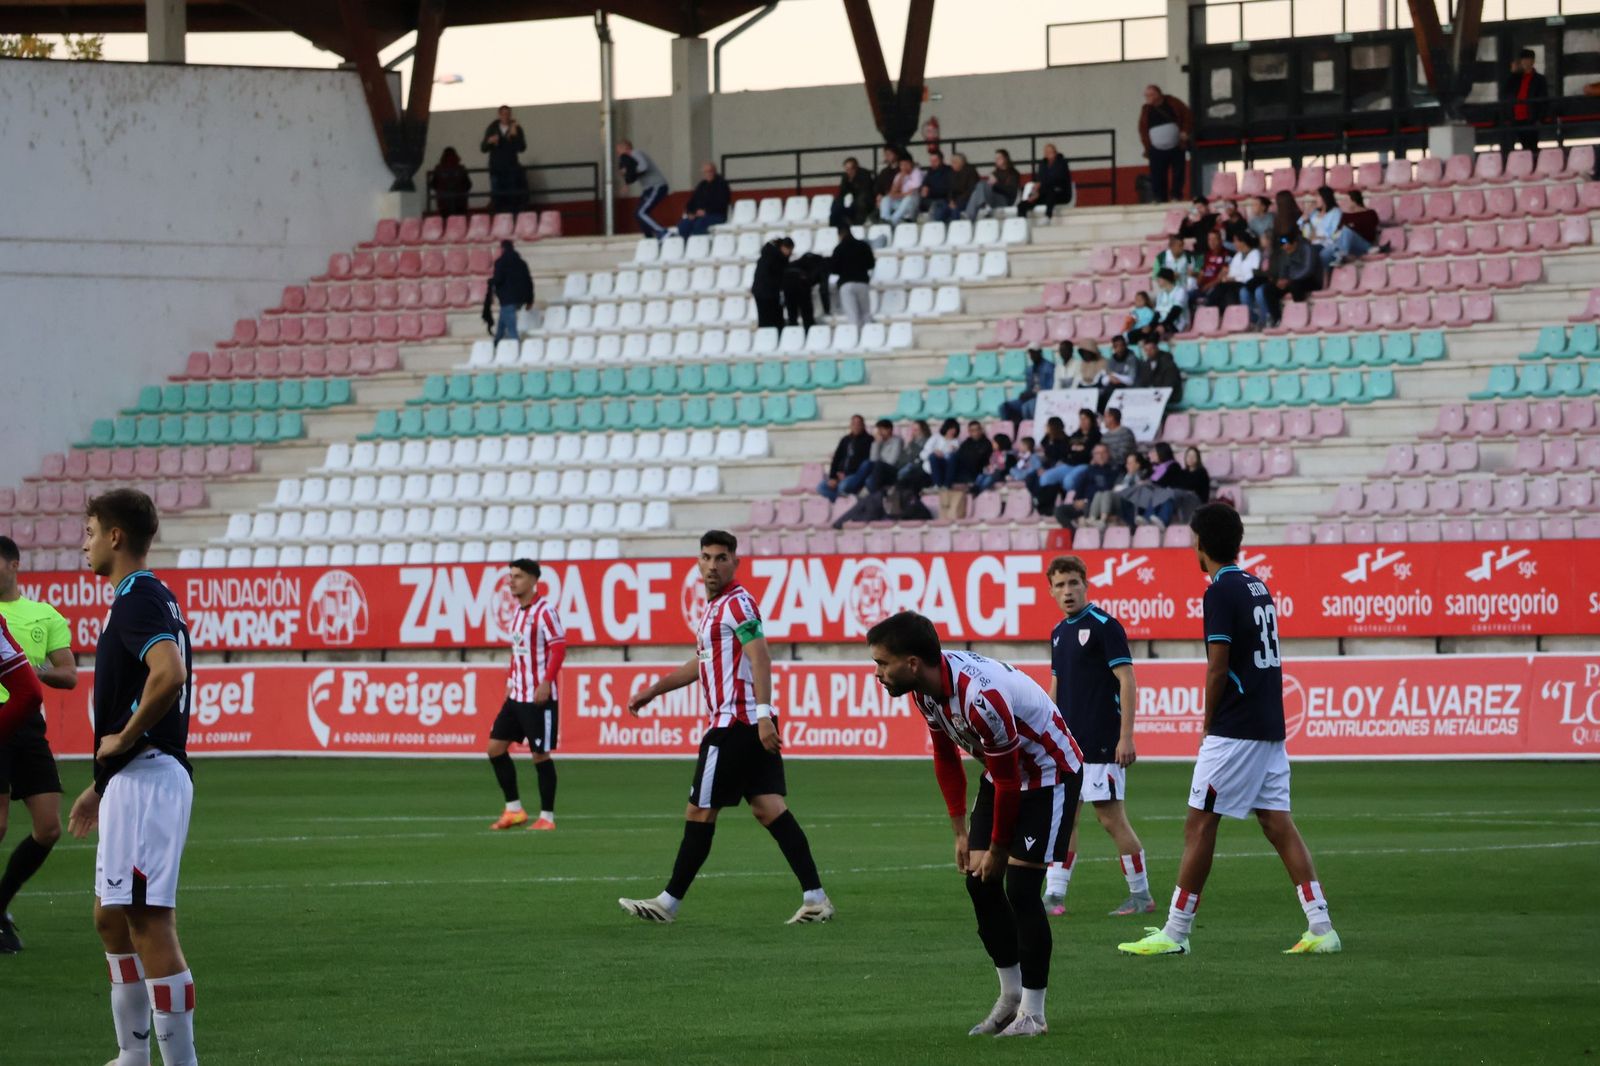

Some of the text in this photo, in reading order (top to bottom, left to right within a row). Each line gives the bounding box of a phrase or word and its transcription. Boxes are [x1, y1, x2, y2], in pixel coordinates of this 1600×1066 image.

[187, 571, 300, 608] FUNDACIÓN
[602, 561, 672, 641] CF
[752, 554, 1042, 638] ZAMORA CF
[1321, 588, 1433, 624] sangregorio
[1445, 587, 1559, 622] sangregorio
[1253, 604, 1281, 669] 33
[338, 671, 477, 726] Freigel
[577, 673, 622, 717] E.S.
[788, 673, 822, 717] LA
[1308, 678, 1522, 718] ELOY ÁLVAREZ
[428, 733, 476, 745] COMPANY
[600, 719, 682, 746] Morales
[783, 721, 888, 749] (Zamora)
[1306, 715, 1519, 737] CONTRUCCIONES METÁLICAS
